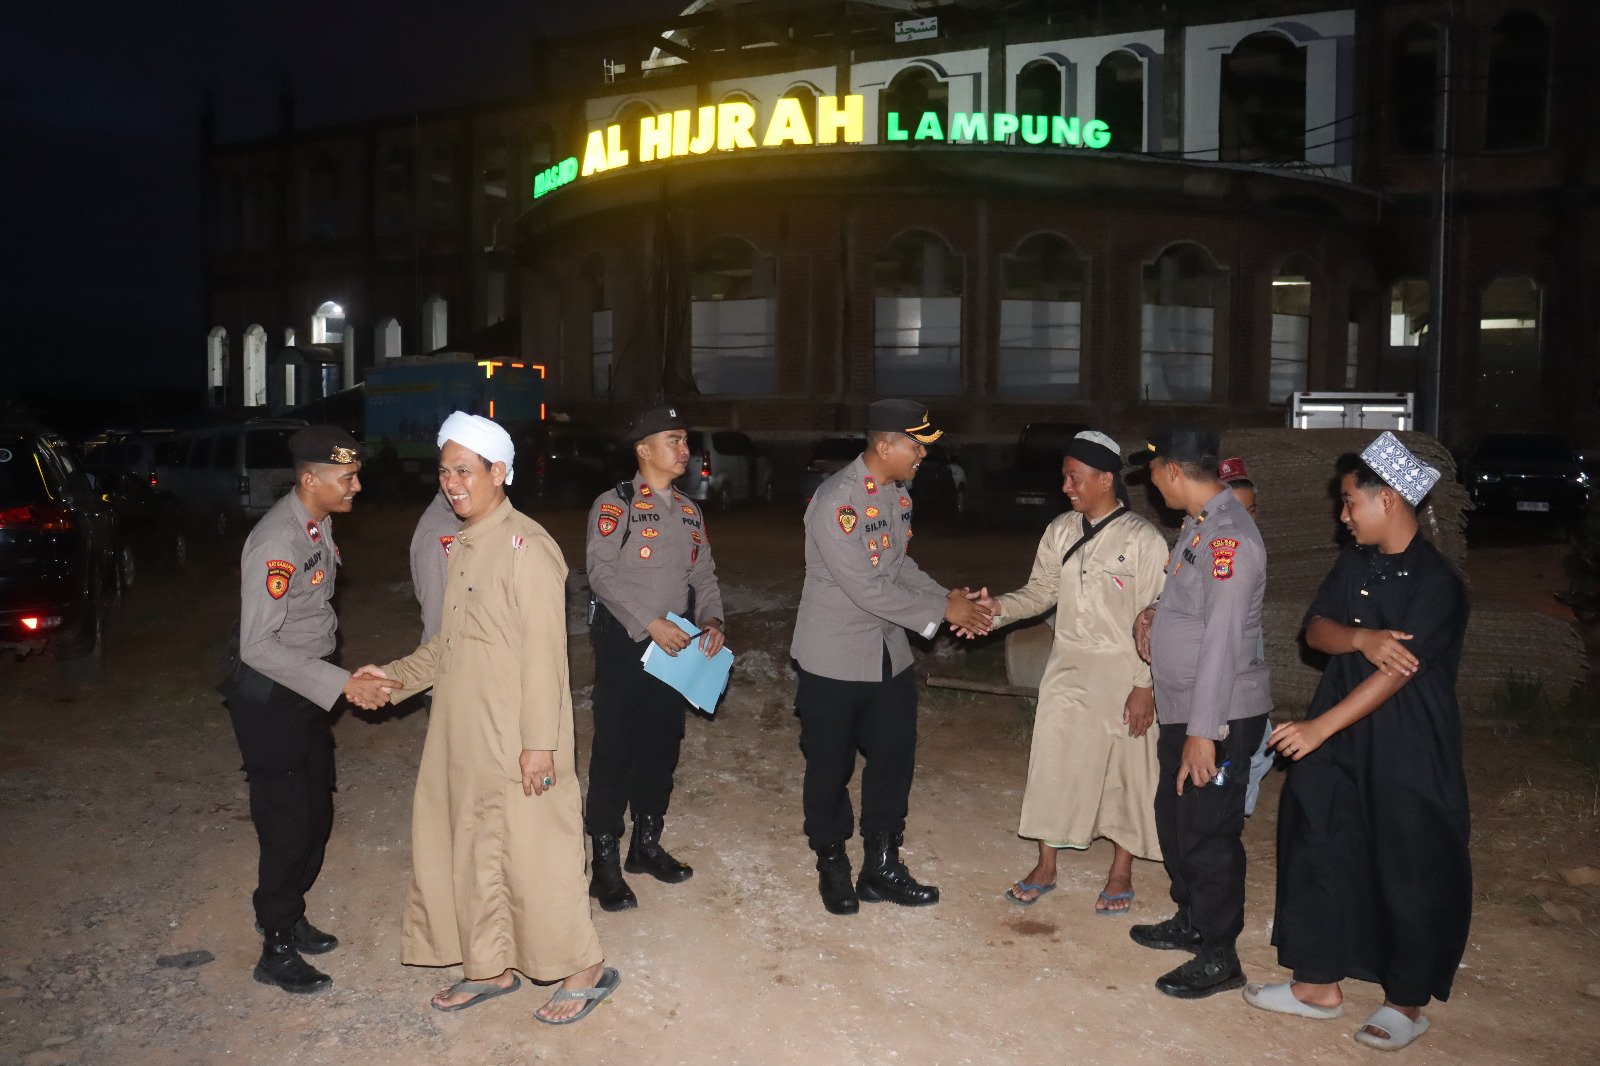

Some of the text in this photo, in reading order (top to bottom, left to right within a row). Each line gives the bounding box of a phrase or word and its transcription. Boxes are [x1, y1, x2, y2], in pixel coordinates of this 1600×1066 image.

[581, 129, 629, 177] AL
[640, 95, 864, 162] HIJRAH
[887, 112, 1111, 149] LAMPUNG
[631, 513, 660, 522] LINTO
